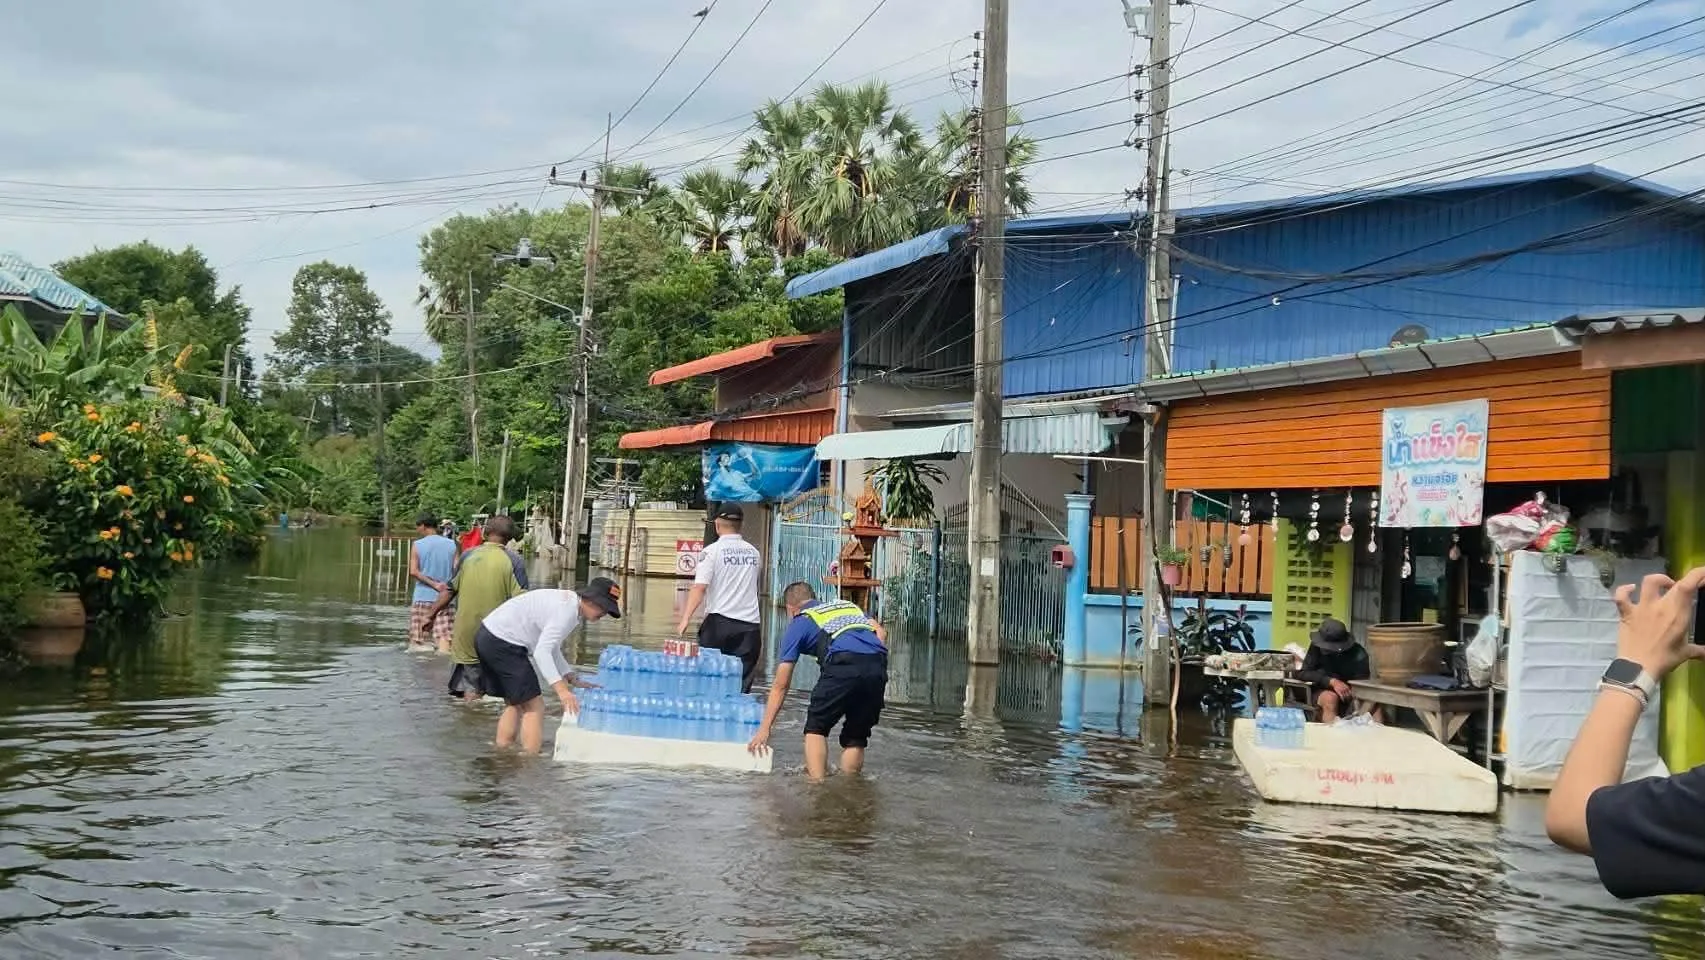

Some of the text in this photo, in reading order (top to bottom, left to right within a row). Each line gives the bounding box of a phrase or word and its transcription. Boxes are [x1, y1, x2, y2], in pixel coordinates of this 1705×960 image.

[1388, 420, 1482, 464] น้ำแข็งใส
[721, 547, 757, 556] TOURIST
[723, 555, 758, 567] POLICE
